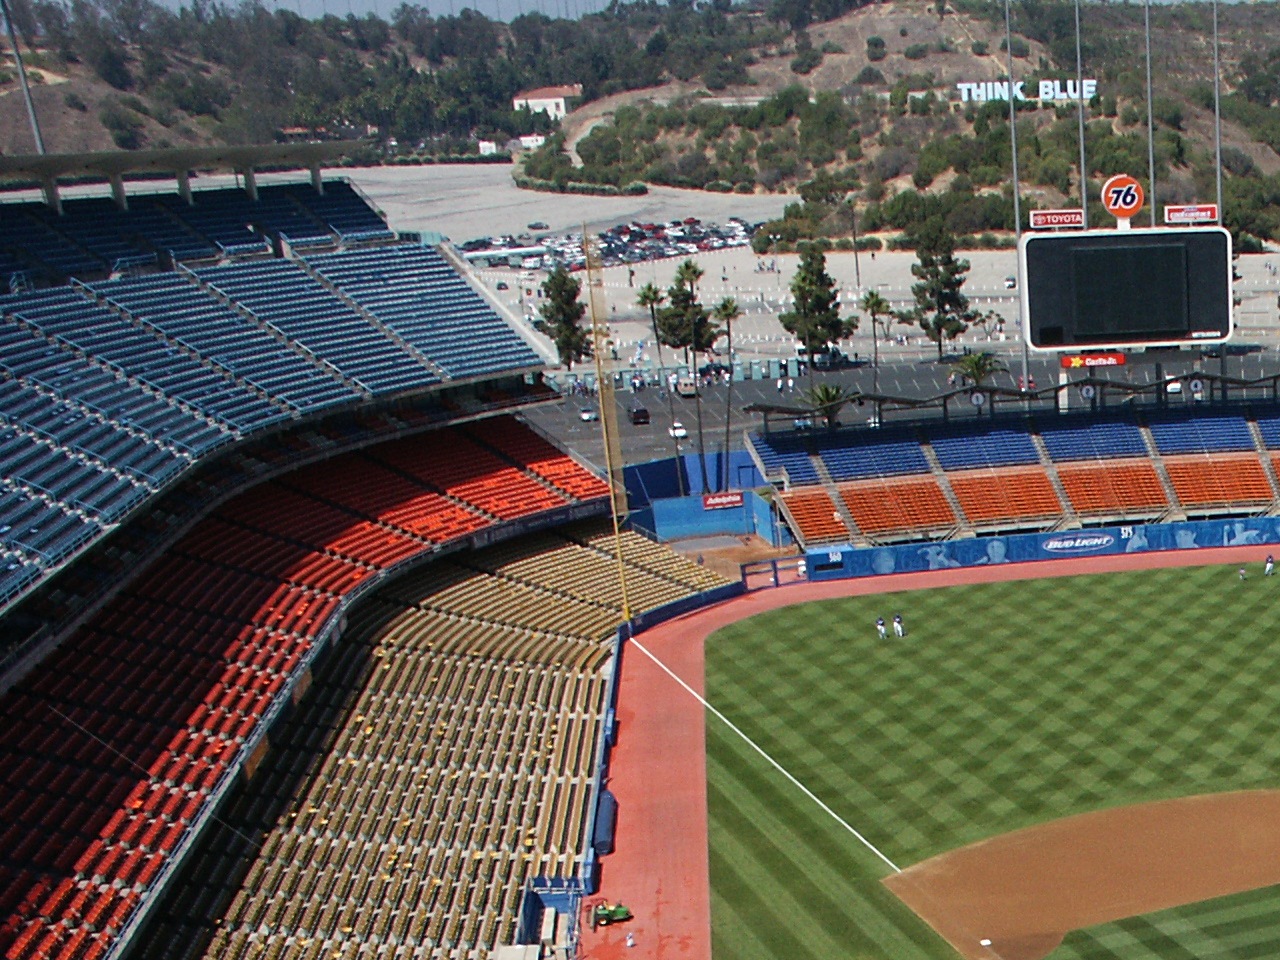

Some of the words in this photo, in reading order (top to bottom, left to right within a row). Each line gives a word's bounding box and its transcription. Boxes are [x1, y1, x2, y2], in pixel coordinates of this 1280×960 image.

[957, 81, 1025, 102] THINK
[1039, 79, 1097, 99] BLUE
[1109, 185, 1138, 209] 76
[1046, 214, 1082, 224] TOYOTA
[1047, 540, 1074, 549] BUD
[1075, 537, 1109, 547] LIGHT
